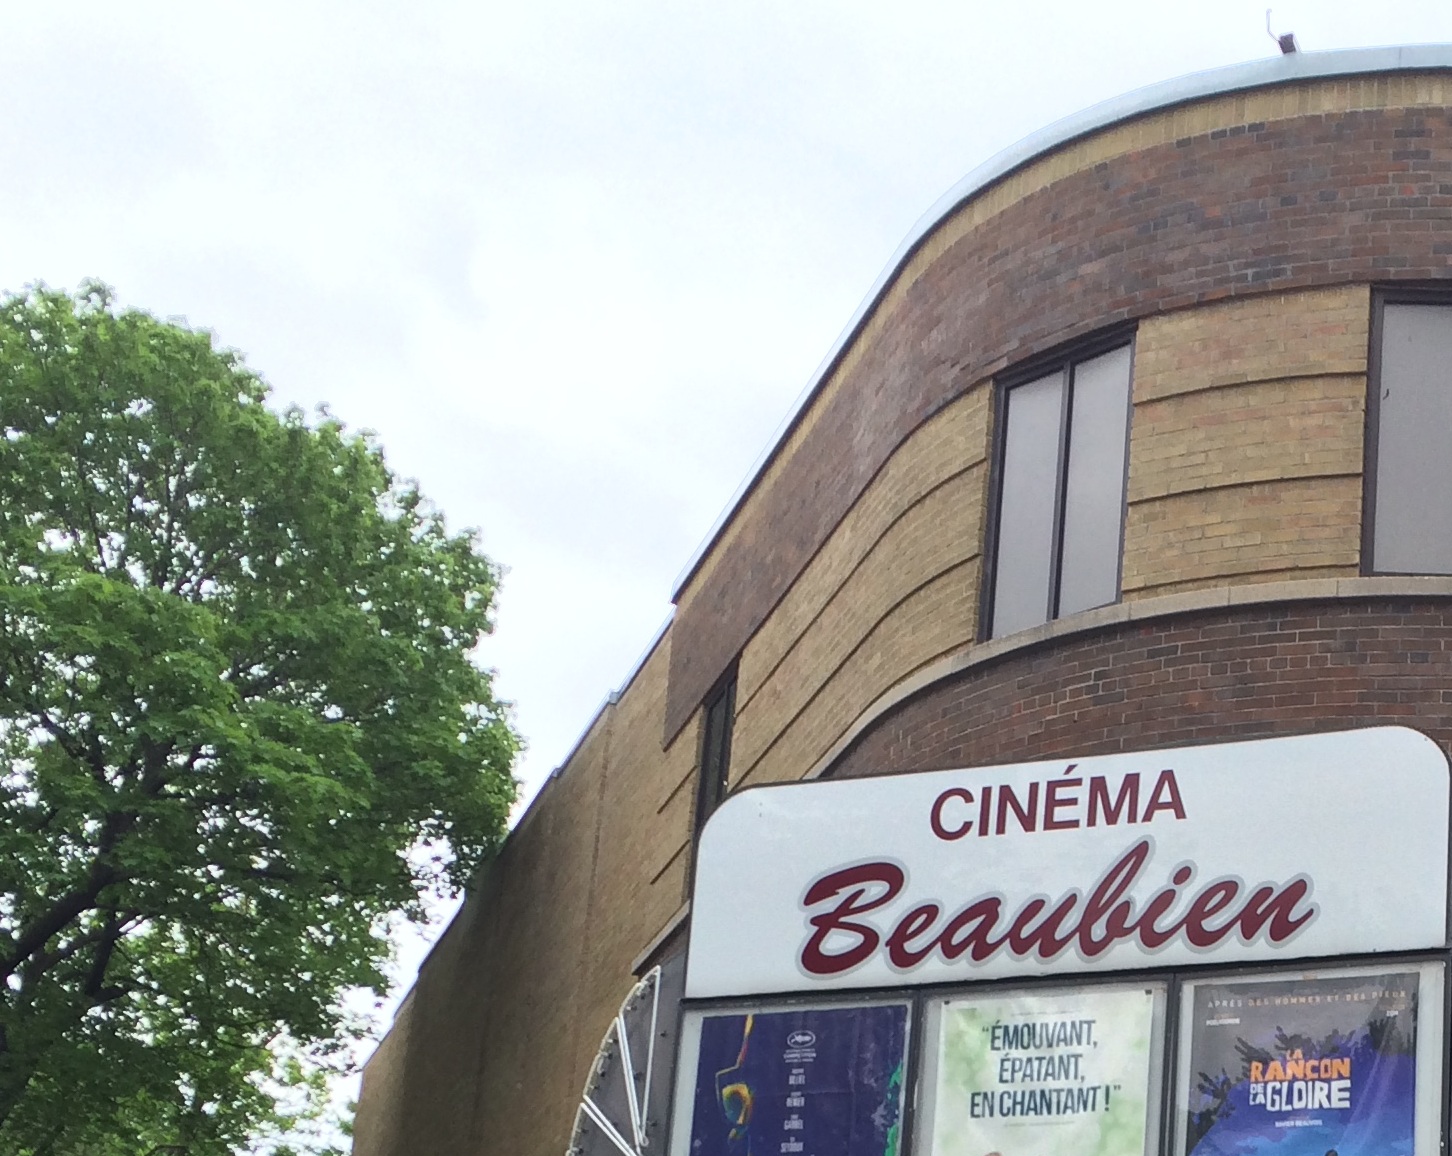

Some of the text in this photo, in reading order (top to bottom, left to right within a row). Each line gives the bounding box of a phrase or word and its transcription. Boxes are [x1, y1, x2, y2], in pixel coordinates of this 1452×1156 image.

[930, 765, 1187, 841] CINÉMA
[801, 841, 1314, 974] Beaubien
[998, 1052, 1085, 1083] ÉPATANT,
[1286, 1048, 1303, 1060] LA
[970, 1091, 995, 1118] EN
[1000, 1085, 1101, 1117] CHANTANT
[1249, 1094, 1266, 1105] LA
[1250, 1083, 1265, 1094] DE
[1266, 1079, 1351, 1112] GLOIRE
